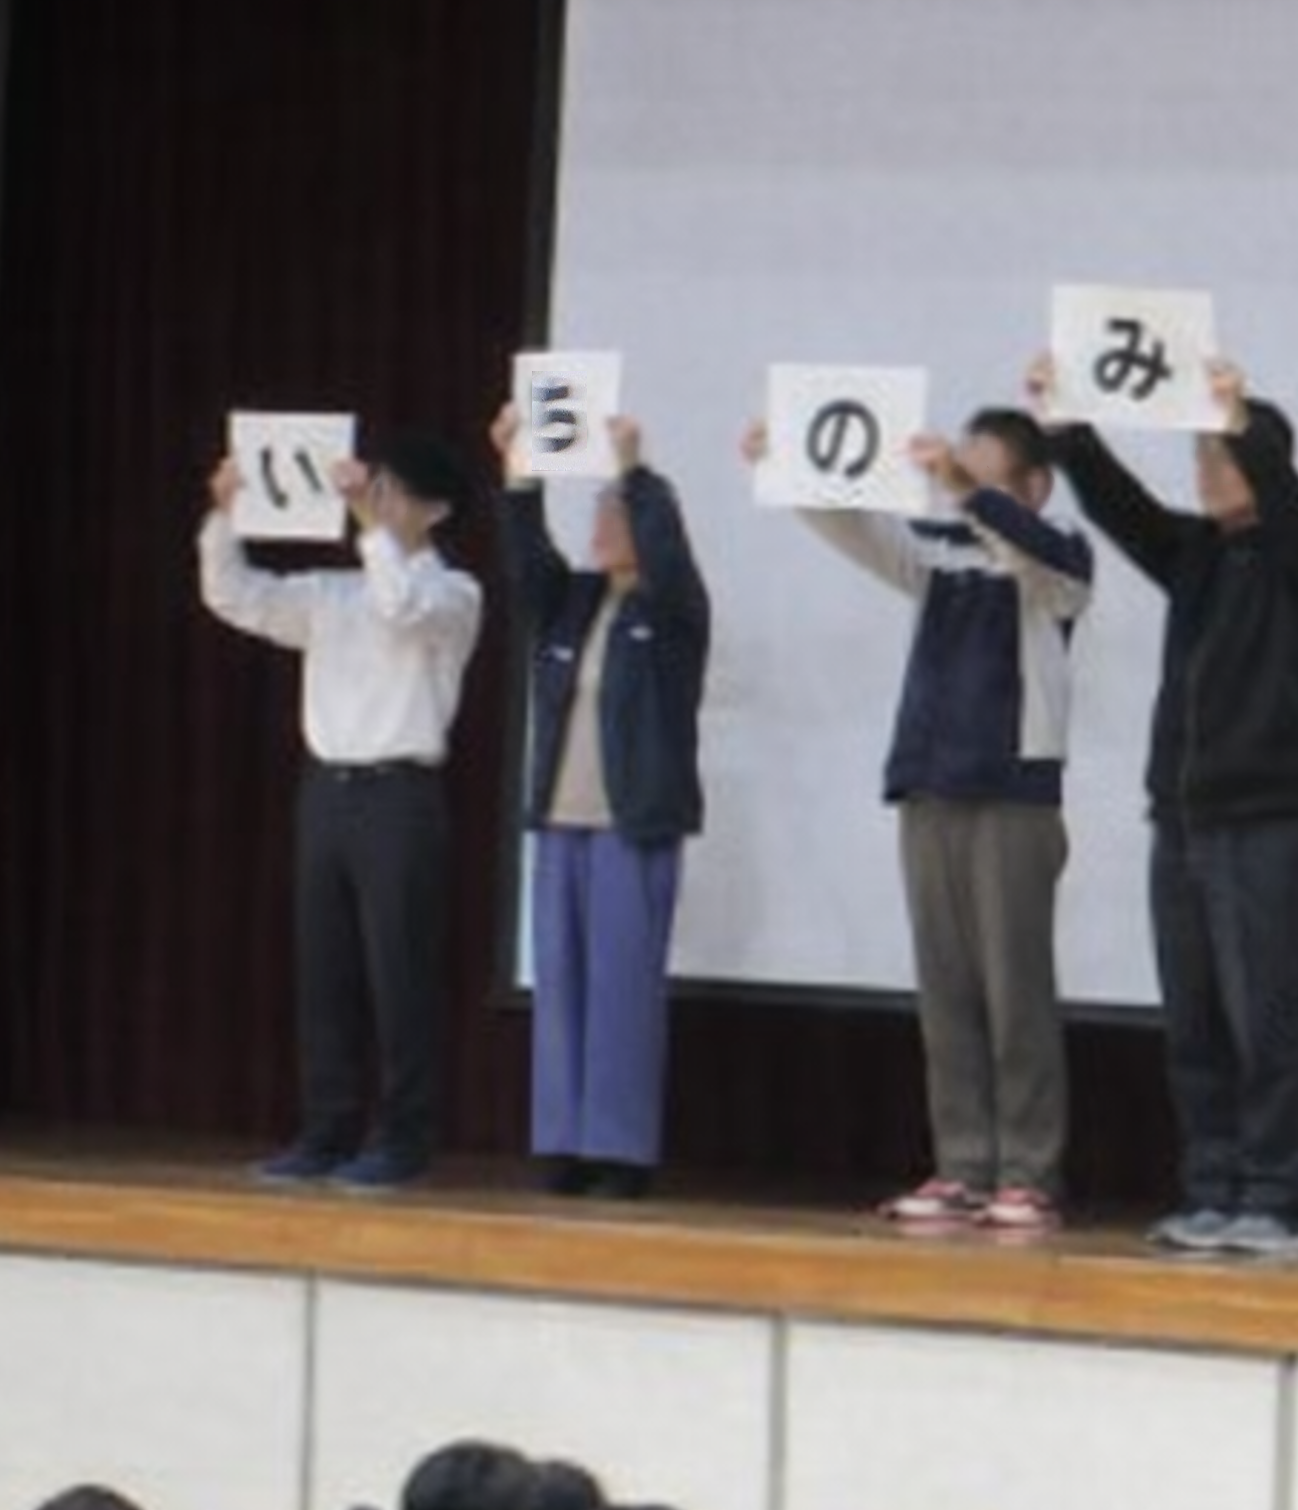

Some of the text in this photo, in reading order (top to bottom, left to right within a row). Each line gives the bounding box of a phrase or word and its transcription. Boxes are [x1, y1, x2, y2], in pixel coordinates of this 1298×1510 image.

[1093, 316, 1172, 400] み
[259, 446, 322, 508] い
[805, 399, 879, 478] の
